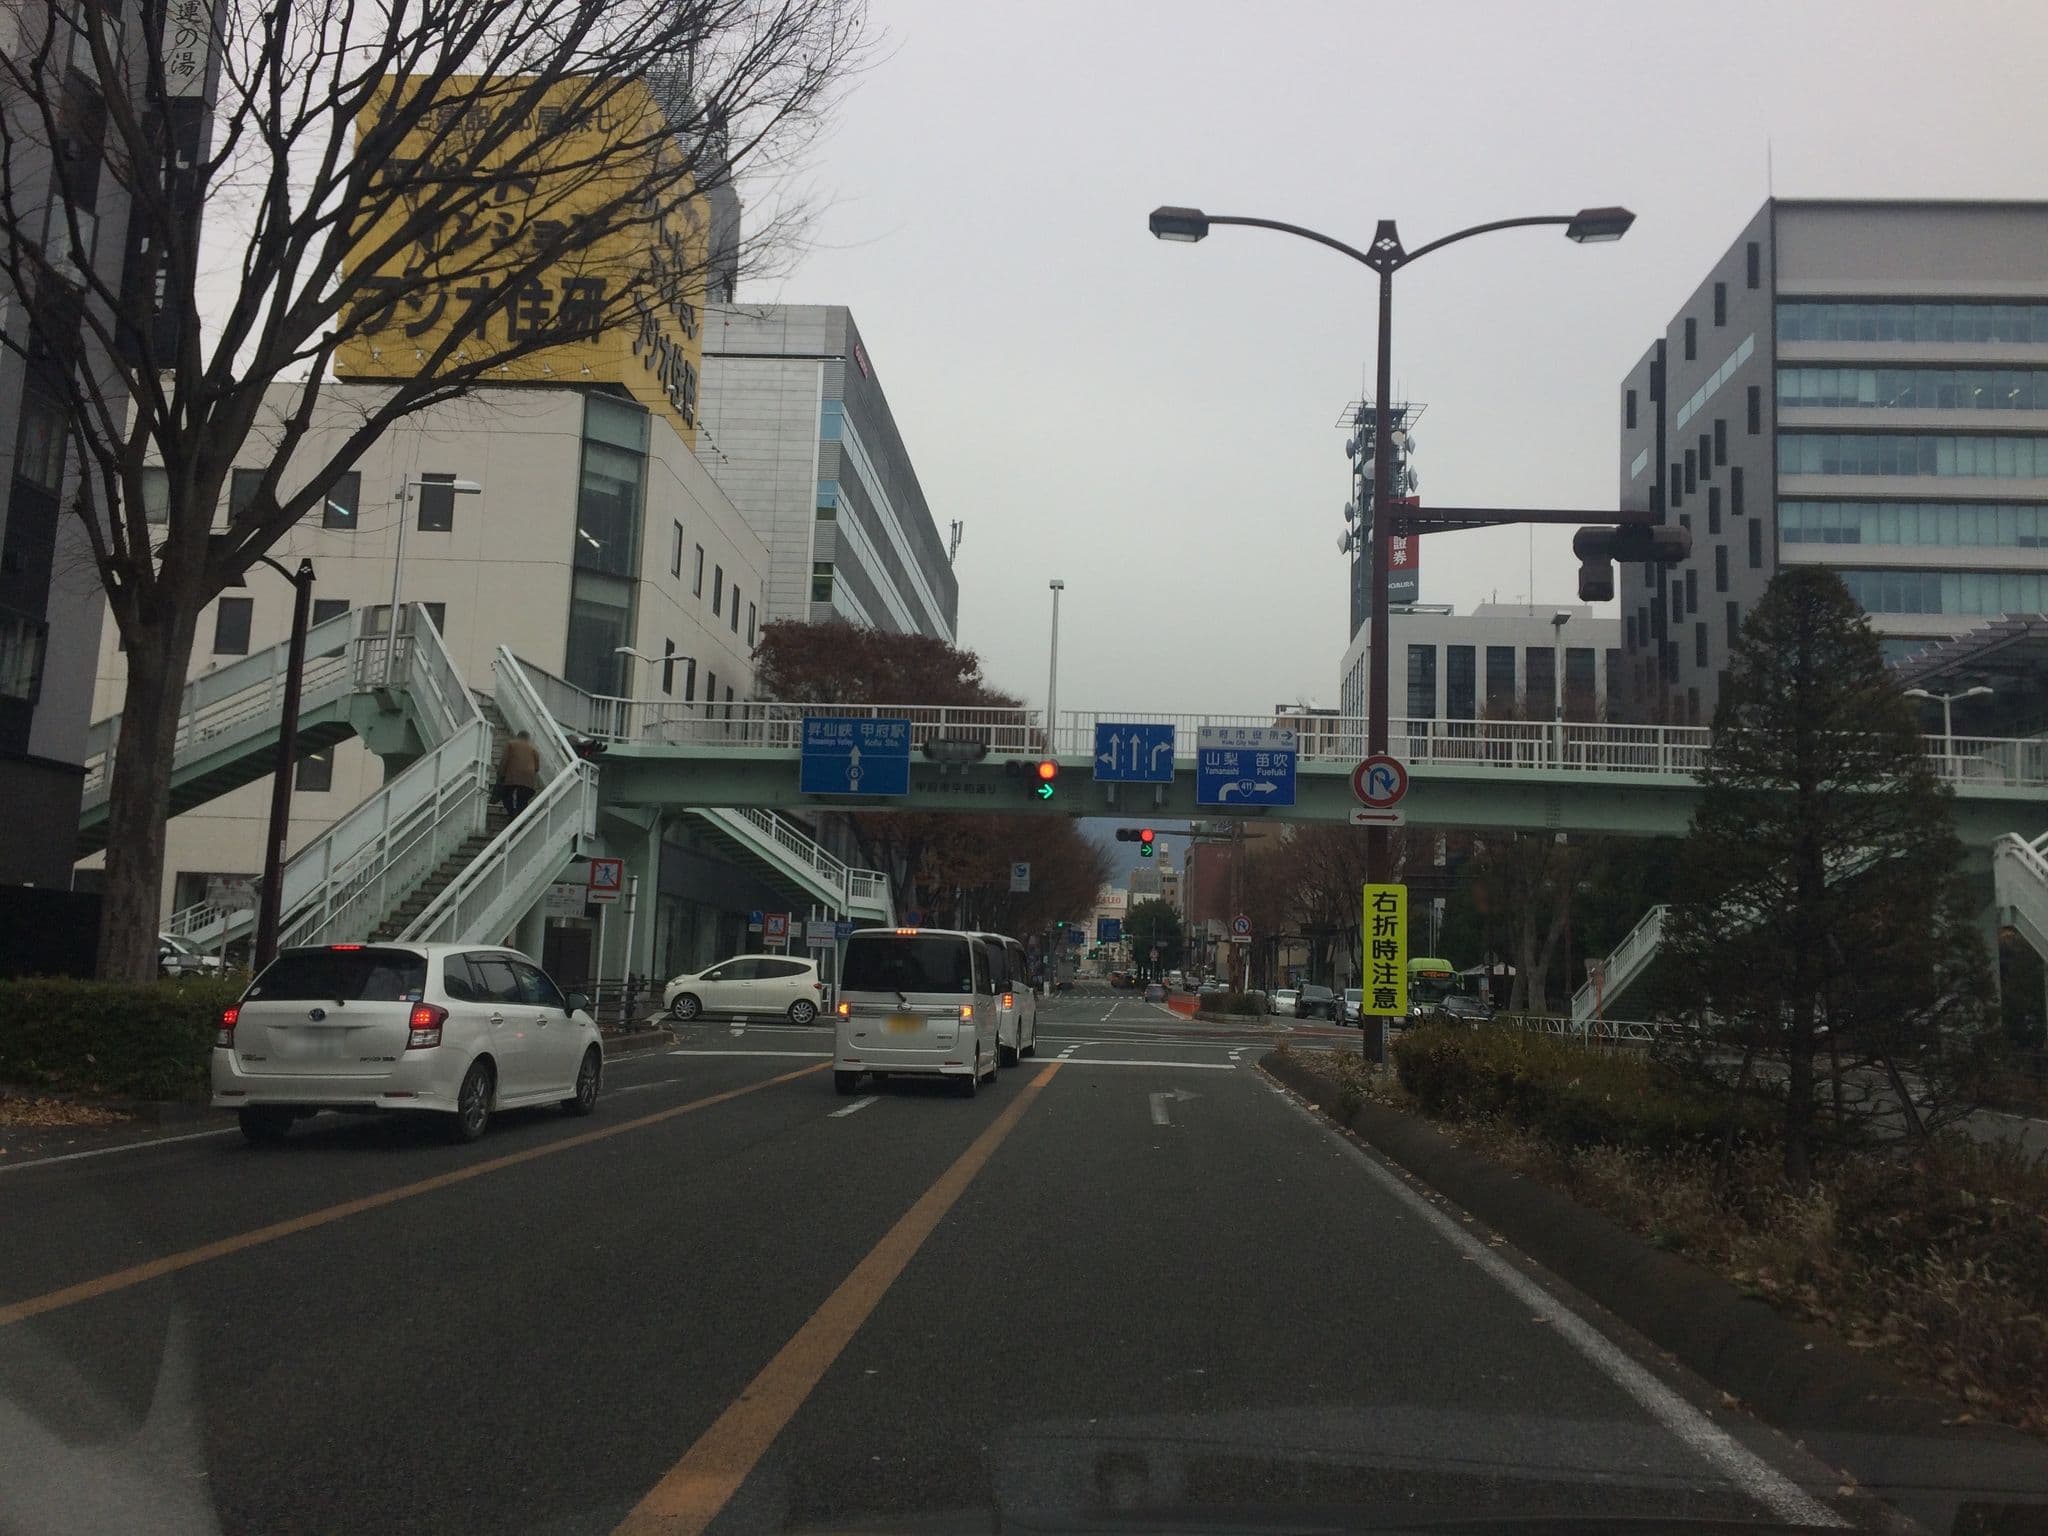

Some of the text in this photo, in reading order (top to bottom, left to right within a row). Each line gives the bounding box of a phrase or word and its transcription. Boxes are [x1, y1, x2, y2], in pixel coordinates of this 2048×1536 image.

[808, 722, 904, 738] 昇仙峡 甲府駅
[1202, 728, 1279, 740] 甲府市役所
[1206, 752, 1288, 768] 山梨 笛吹
[851, 767, 858, 778] 6
[1205, 766, 1287, 776] Yamanashi Fuefuki
[1240, 782, 1252, 790] 411
[1372, 891, 1398, 1009] 右折時注意
